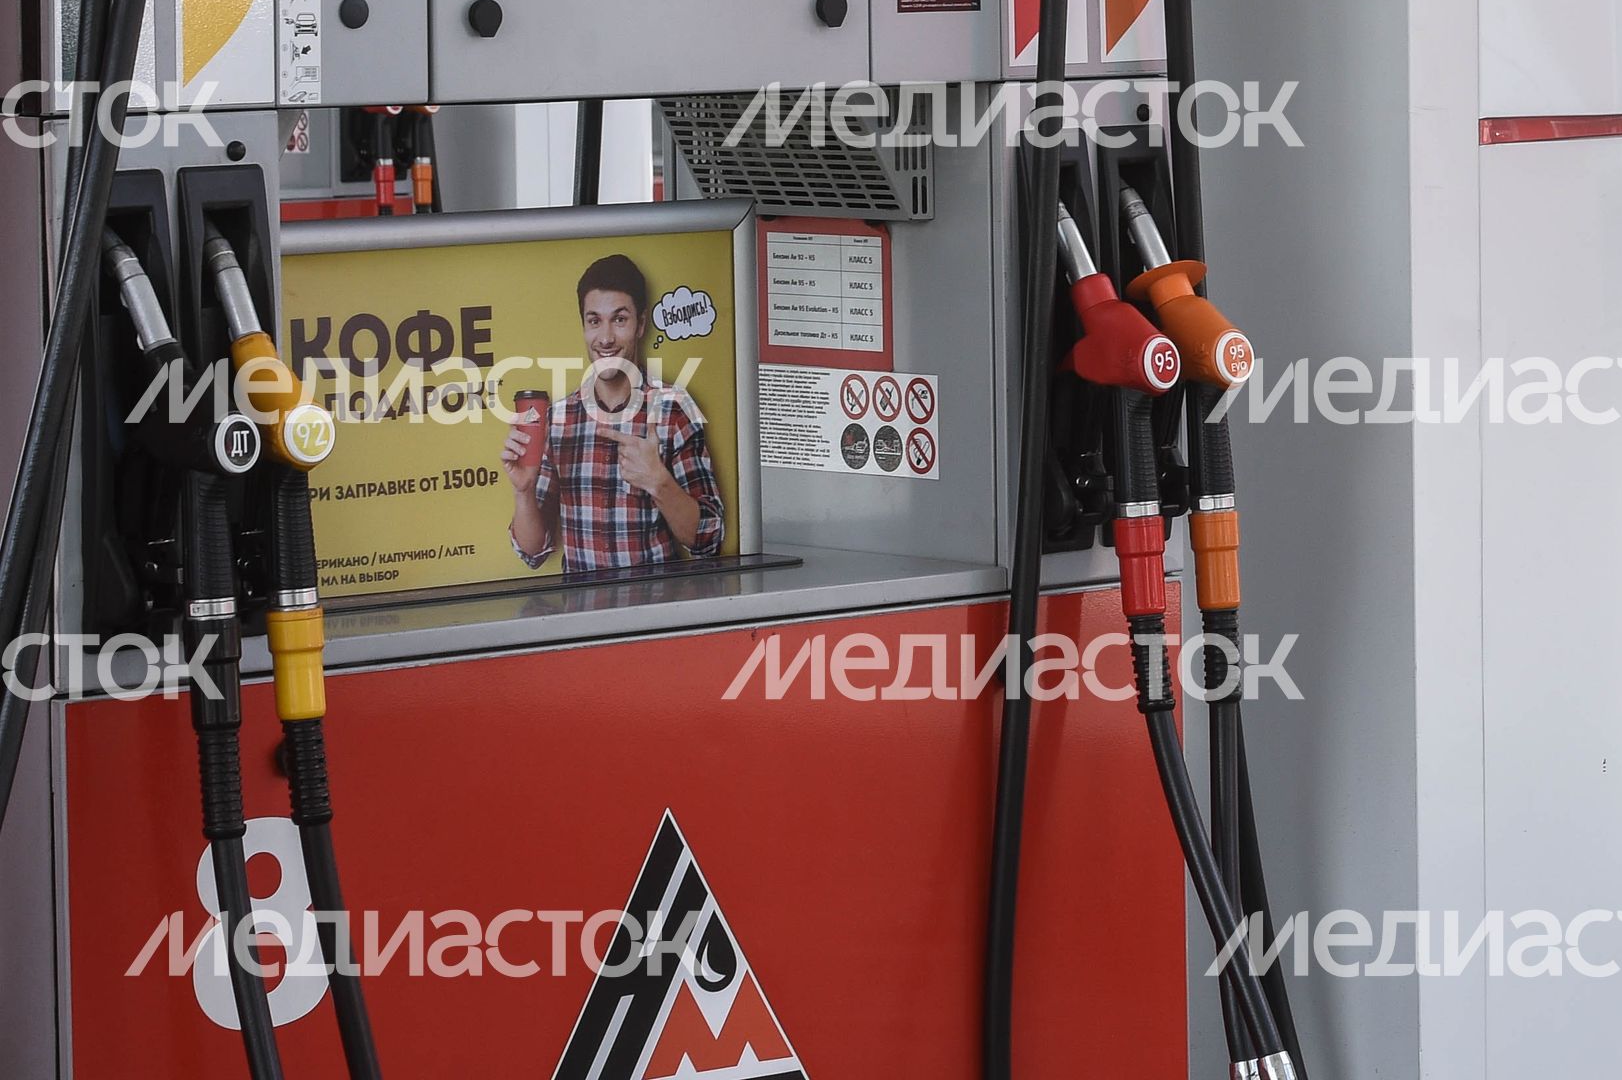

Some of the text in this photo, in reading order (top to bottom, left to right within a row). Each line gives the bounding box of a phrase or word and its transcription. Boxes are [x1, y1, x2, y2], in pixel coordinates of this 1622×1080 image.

[849, 256, 868, 264] КЛАСС
[849, 282, 868, 290] КЛАСС
[661, 295, 708, 327] Взбодрись!
[850, 308, 868, 316] КЛАСС
[289, 305, 494, 382] КОФЕ
[1229, 344, 1245, 360] 95
[1154, 350, 1175, 373] 95
[1231, 361, 1248, 372] EVO
[231, 429, 250, 458] ДТ
[296, 420, 328, 449] 92
[309, 487, 331, 502] РИ
[335, 478, 416, 502] ЗАПРАВКЕ
[419, 476, 439, 492] ОТ
[316, 554, 370, 571] ЕРИКАНО
[379, 548, 437, 566] КАПУЧИНО
[321, 570, 399, 587] МЛ НА ВЫБОР
[193, 816, 330, 1031] 8
